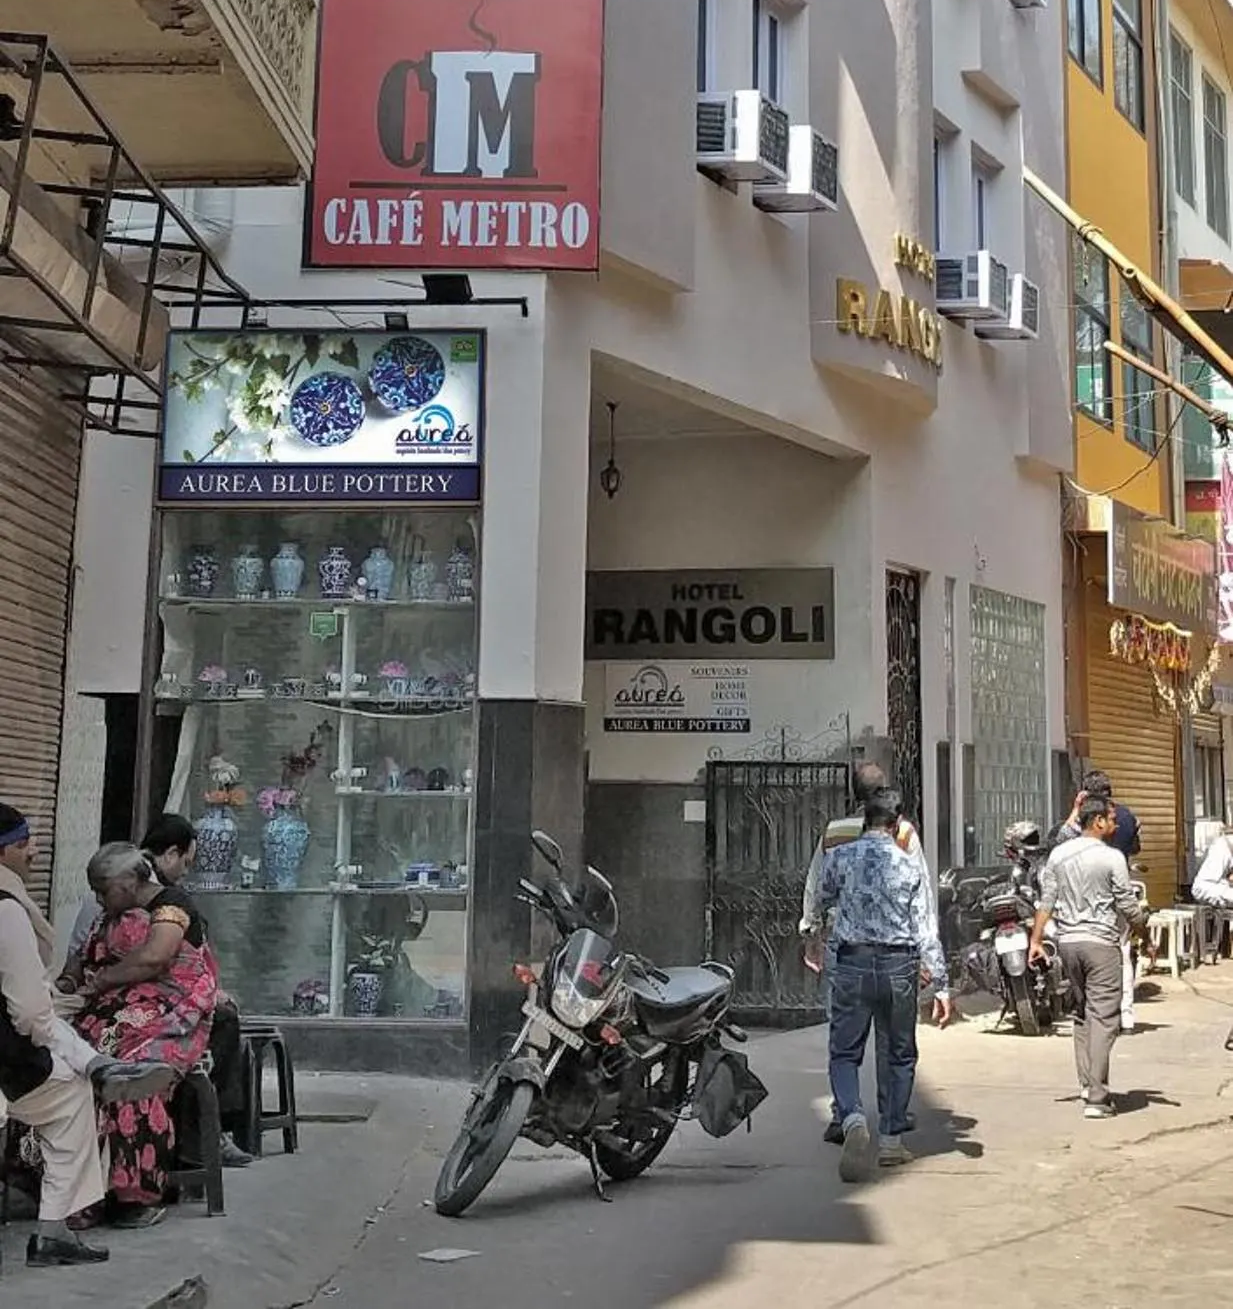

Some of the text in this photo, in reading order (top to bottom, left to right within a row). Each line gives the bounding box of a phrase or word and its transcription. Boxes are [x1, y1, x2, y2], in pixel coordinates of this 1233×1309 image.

[323, 190, 590, 249] CAFÉ METRO
[836, 276, 943, 368] RANG
[179, 473, 453, 493] AUREA BLUE POTTERY
[671, 583, 745, 601] HOTEL
[592, 605, 827, 644] RANGOLI
[609, 720, 746, 730] AUREA BLUE POTTERY
